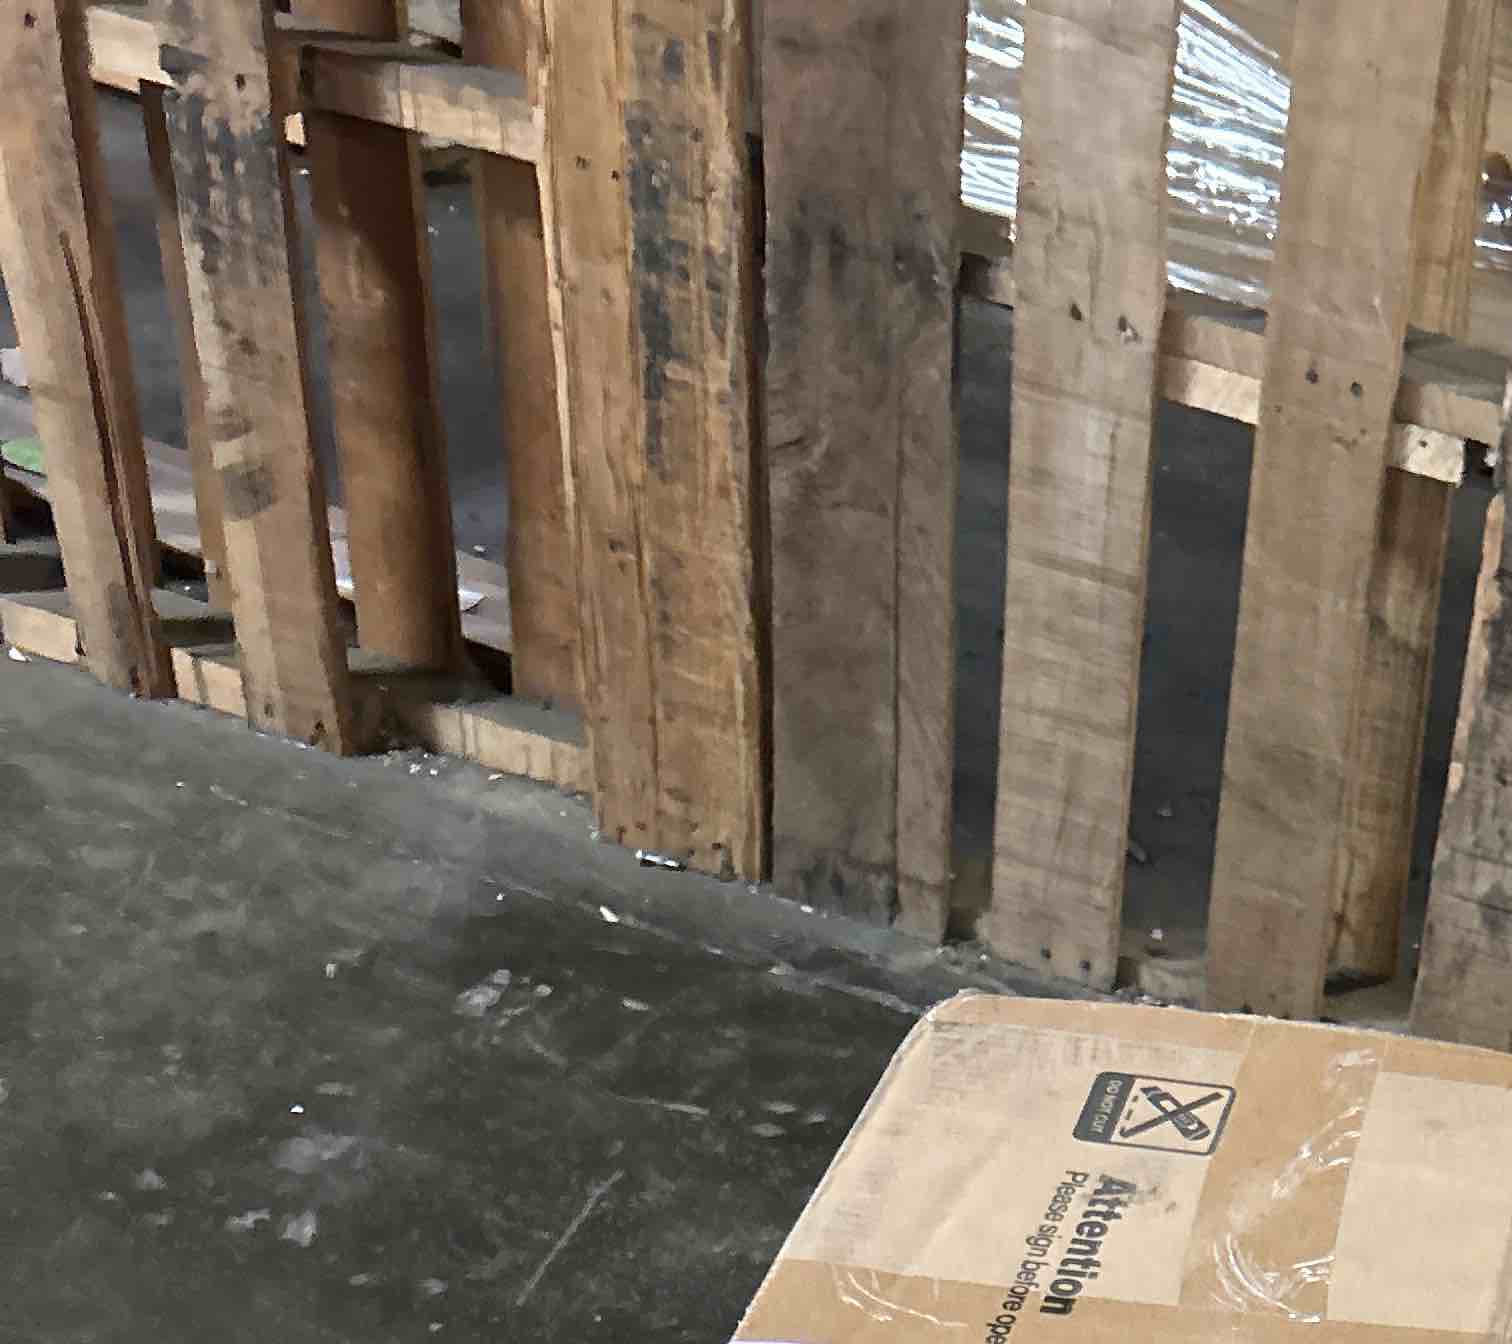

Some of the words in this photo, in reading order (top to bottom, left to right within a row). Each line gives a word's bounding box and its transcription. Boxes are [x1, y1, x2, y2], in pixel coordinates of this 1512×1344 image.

[1043, 1169, 1089, 1222] Please
[1023, 1223, 1063, 1258] sign
[1039, 1173, 1137, 1316] Attention
[1001, 1259, 1050, 1312] before
